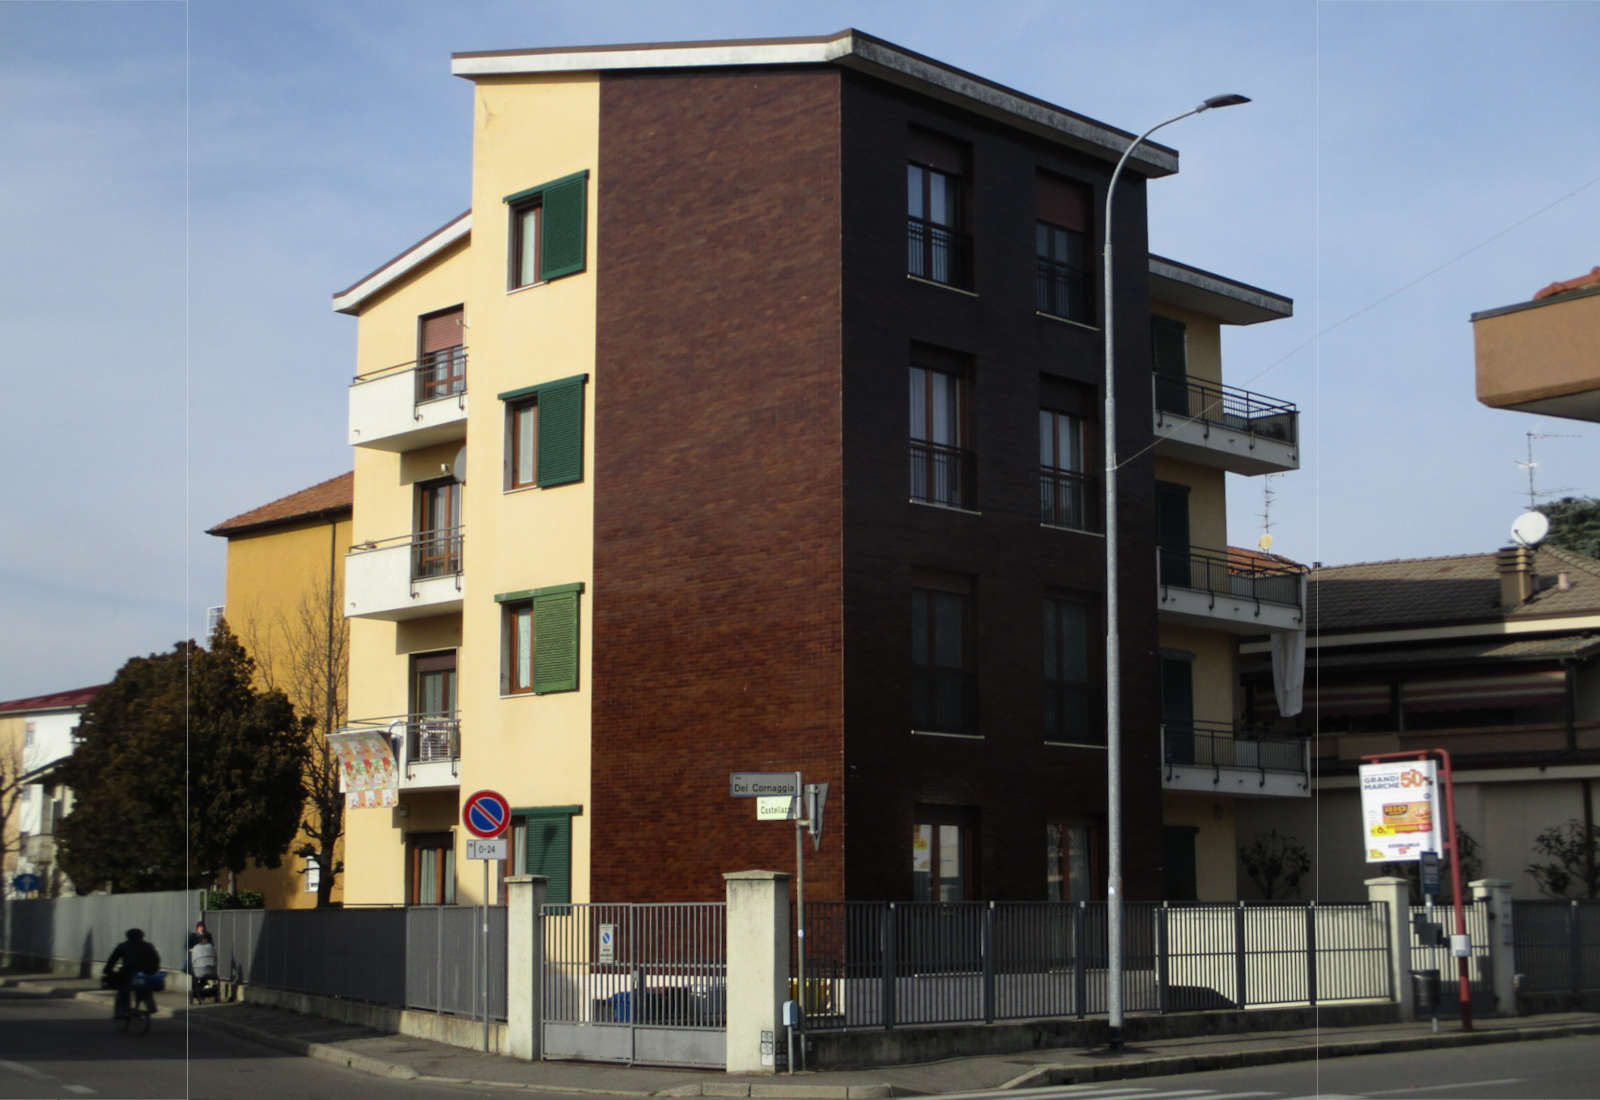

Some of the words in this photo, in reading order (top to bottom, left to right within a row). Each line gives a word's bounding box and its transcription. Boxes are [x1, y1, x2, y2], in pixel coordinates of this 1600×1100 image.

[1364, 775, 1399, 783] GRANDI
[752, 783, 795, 794] Cornaggia
[1364, 782, 1400, 790] MARCHE
